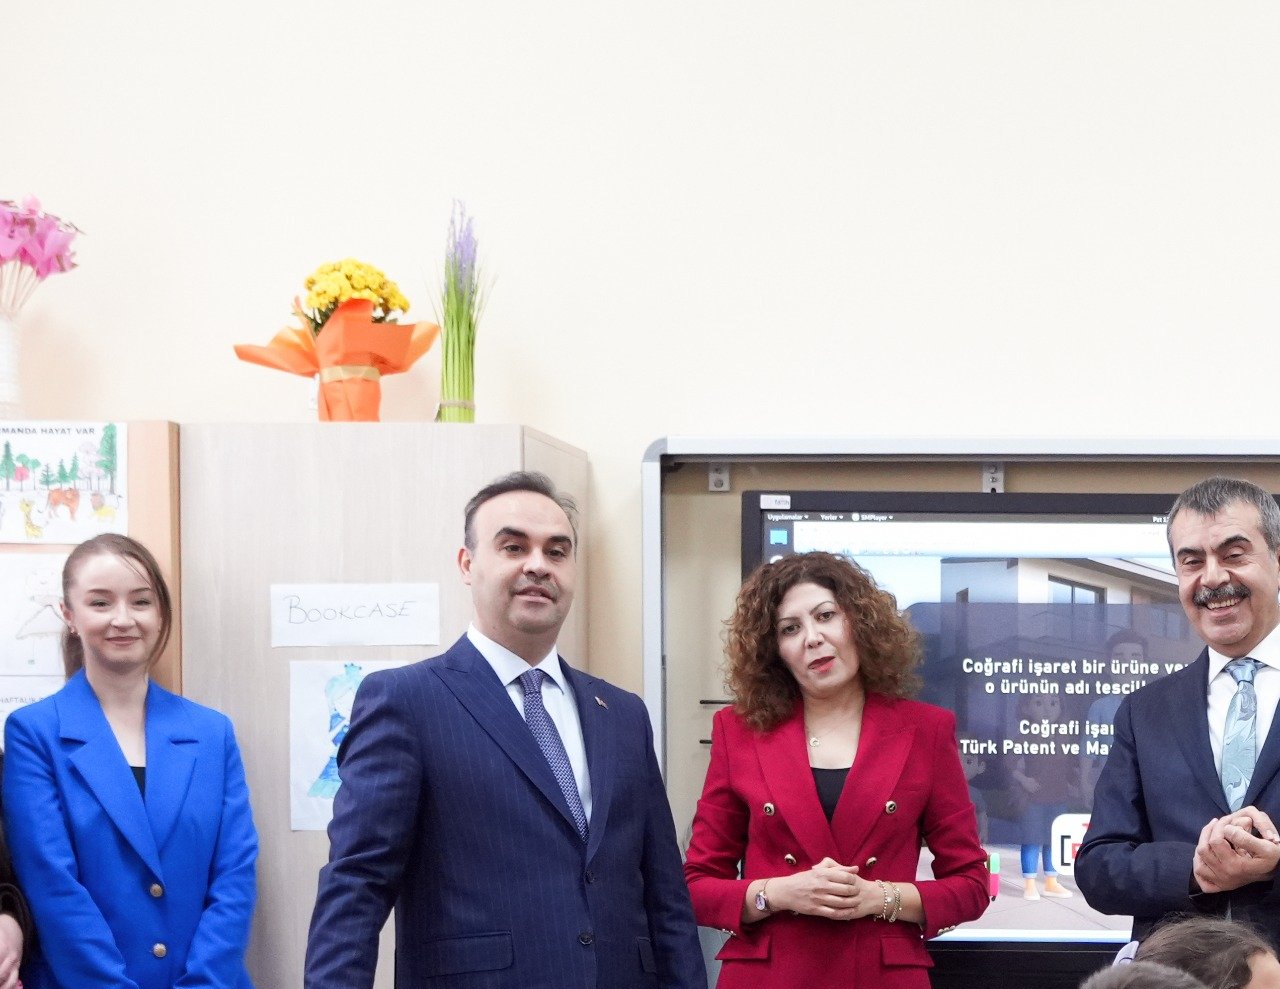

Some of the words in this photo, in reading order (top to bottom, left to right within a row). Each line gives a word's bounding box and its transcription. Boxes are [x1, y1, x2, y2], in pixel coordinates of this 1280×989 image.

[860, 513, 888, 522] SMPlayer
[283, 595, 417, 624] BOOKCASE
[962, 658, 1023, 676] Coğrafi
[1028, 659, 1077, 676] işaret
[1083, 660, 1106, 674] bir
[1111, 659, 1159, 674] ürüne
[1164, 663, 1189, 674] ve
[985, 683, 995, 694] o
[1001, 680, 1059, 694] ürünün
[1065, 681, 1090, 694] adı
[1019, 719, 1079, 738] Coğrafi
[960, 740, 997, 754] Türk
[1003, 740, 1055, 754] Patent
[1061, 743, 1079, 754] ve
[1086, 740, 1113, 755] Ma
